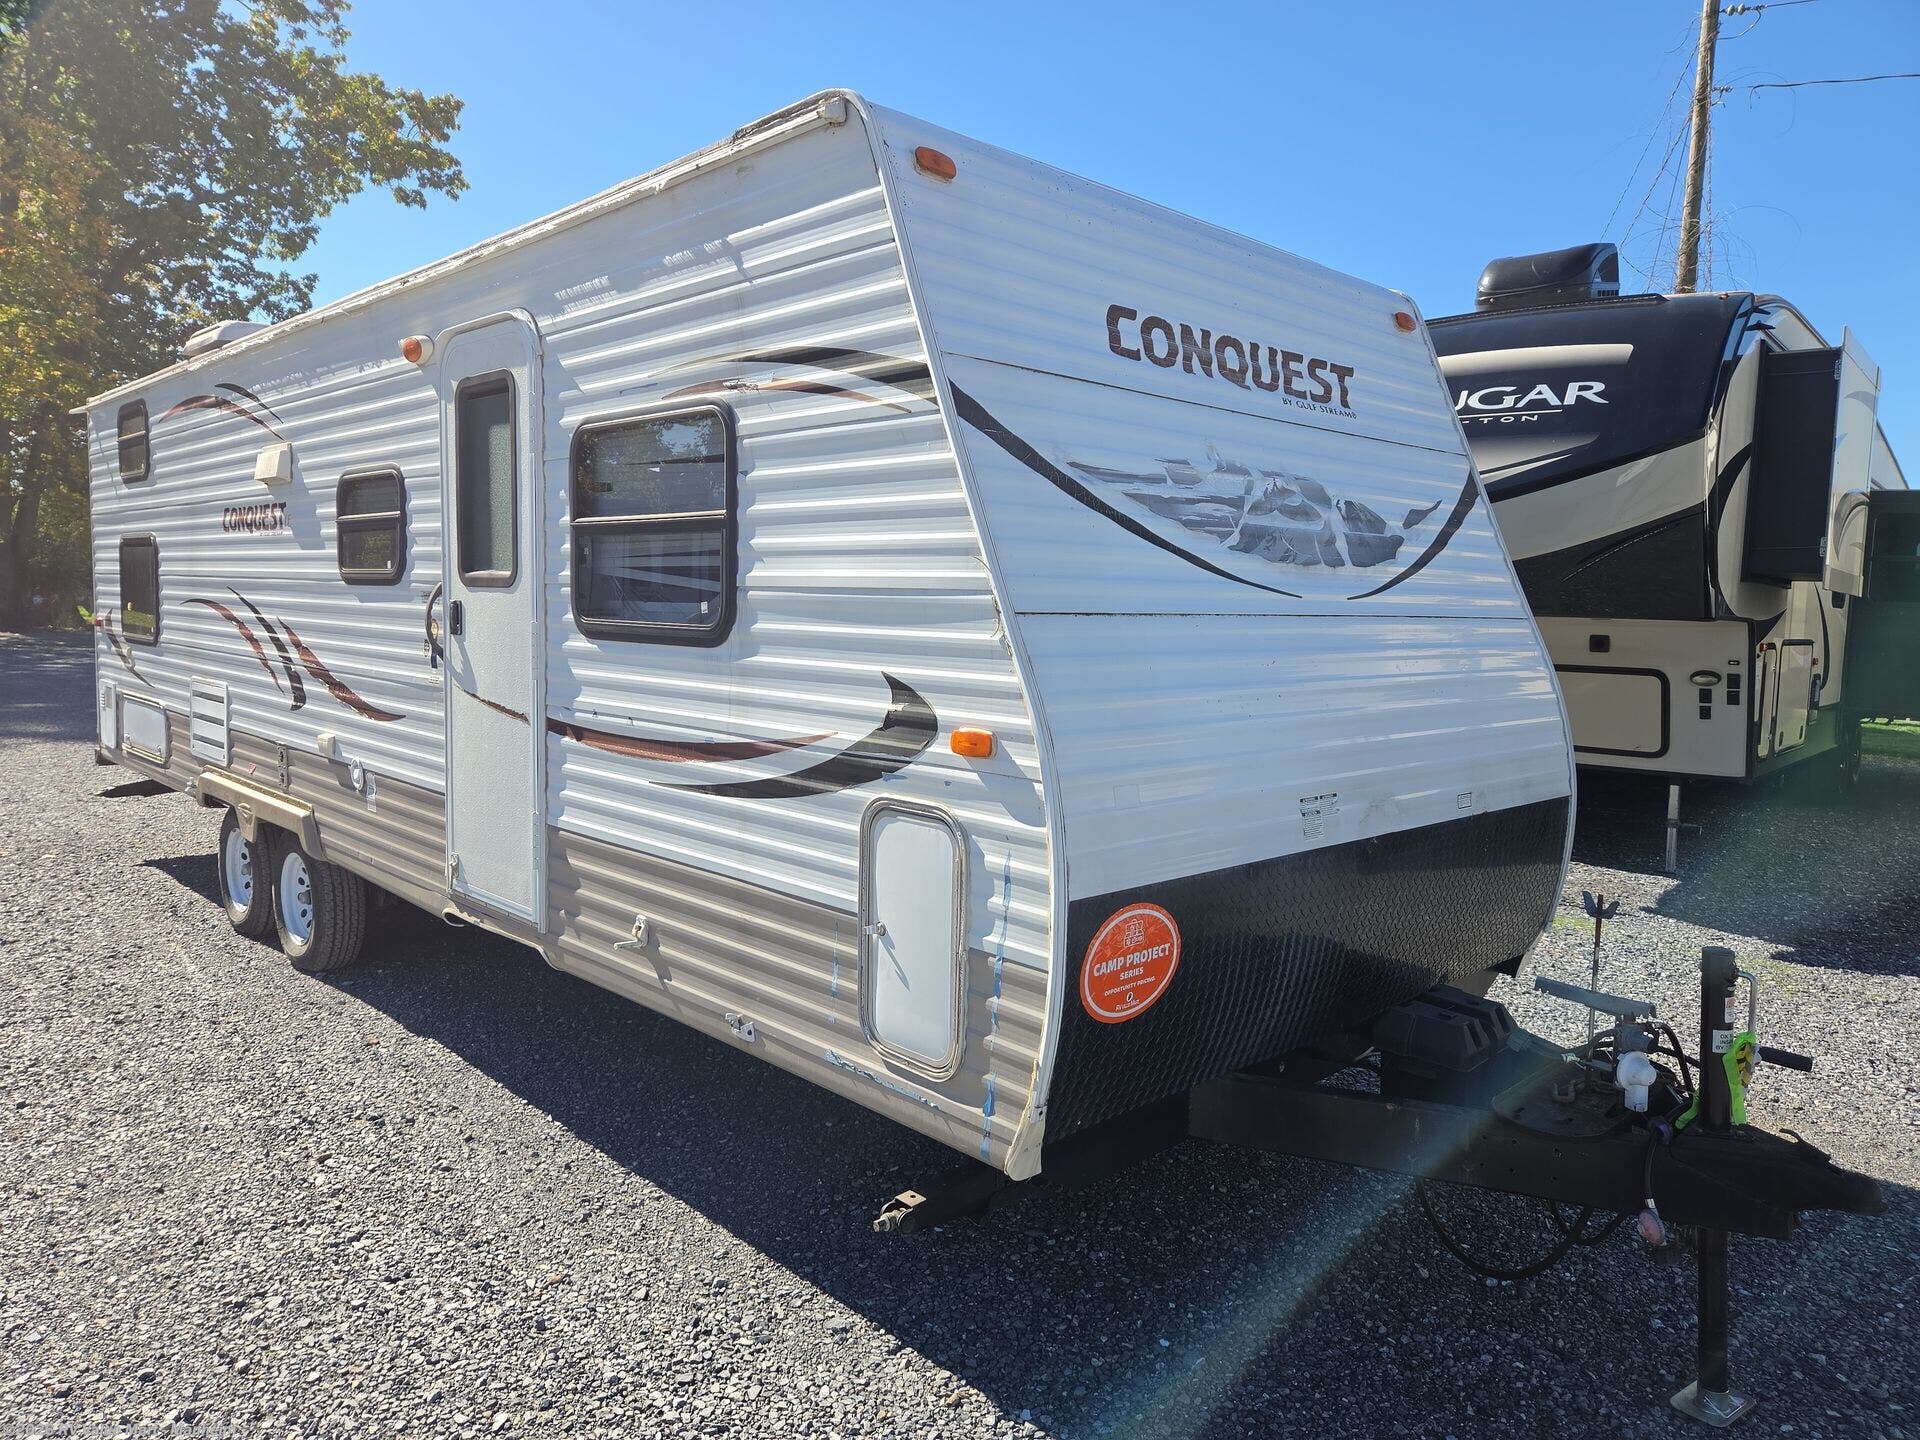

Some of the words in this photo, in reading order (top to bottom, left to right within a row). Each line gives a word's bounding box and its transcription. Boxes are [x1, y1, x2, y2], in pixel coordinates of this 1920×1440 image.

[1106, 304, 1355, 409] CONQUEST
[1282, 397, 1292, 406] BY
[1296, 400, 1317, 411] GULF
[223, 502, 286, 533] CONQUEST
[1094, 957, 1124, 976] CAMP
[1126, 943, 1171, 967] PROJECT
[1120, 967, 1144, 980] SERIES
[1104, 983, 1137, 996] OPPORTUNITY
